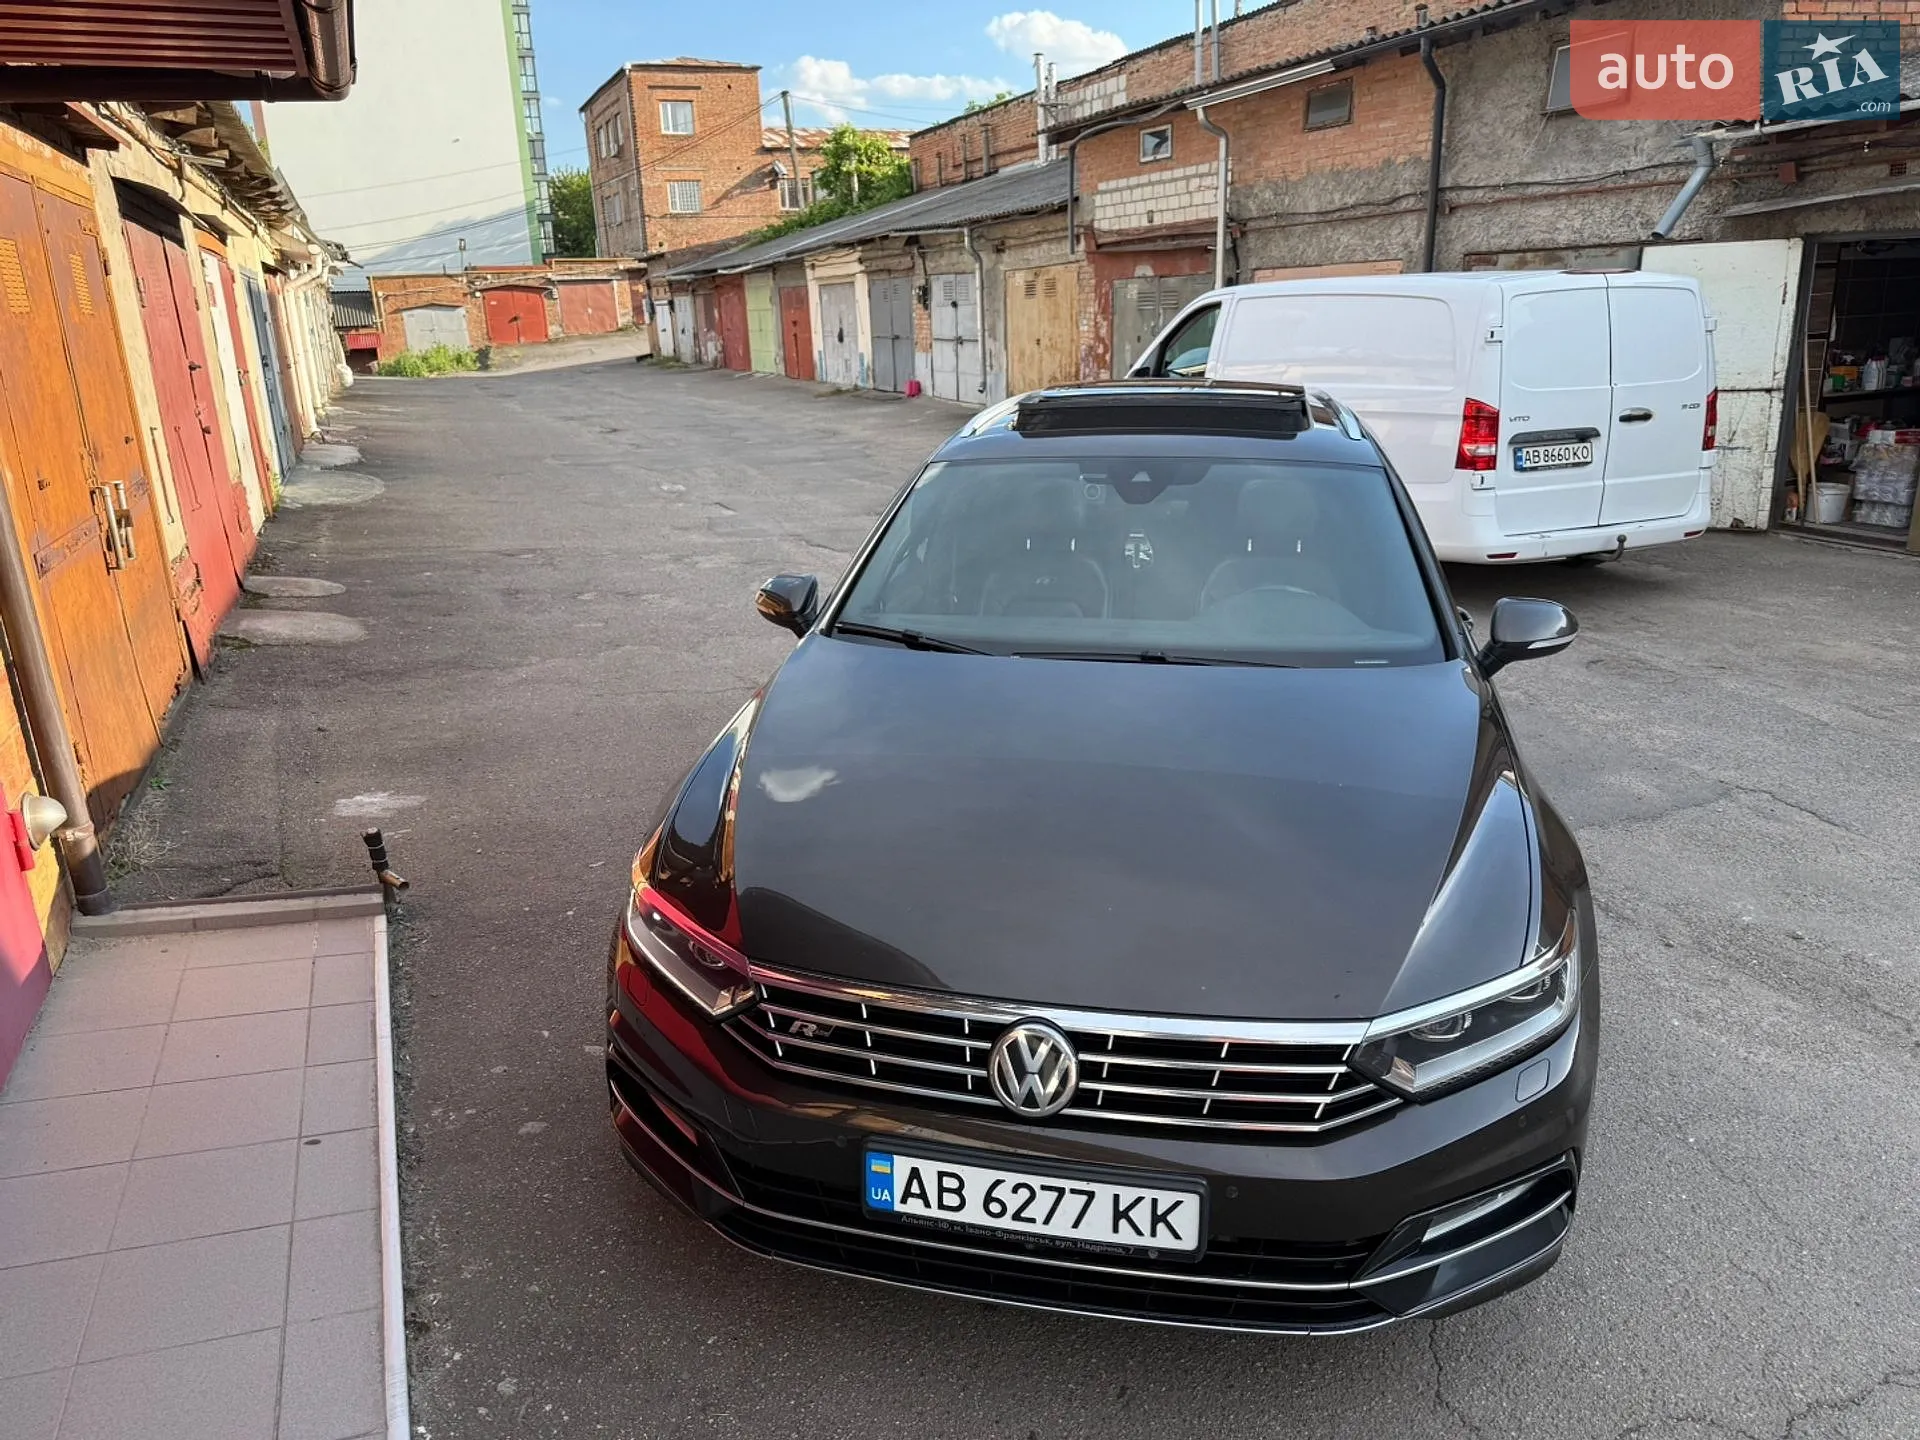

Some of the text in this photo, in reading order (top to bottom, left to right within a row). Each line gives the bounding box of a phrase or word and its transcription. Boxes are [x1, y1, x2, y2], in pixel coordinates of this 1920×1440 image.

[1524, 445, 1589, 464] AB 8660 KO
[871, 1187, 891, 1202] UA
[899, 1166, 1185, 1240] AB 6277 KK
